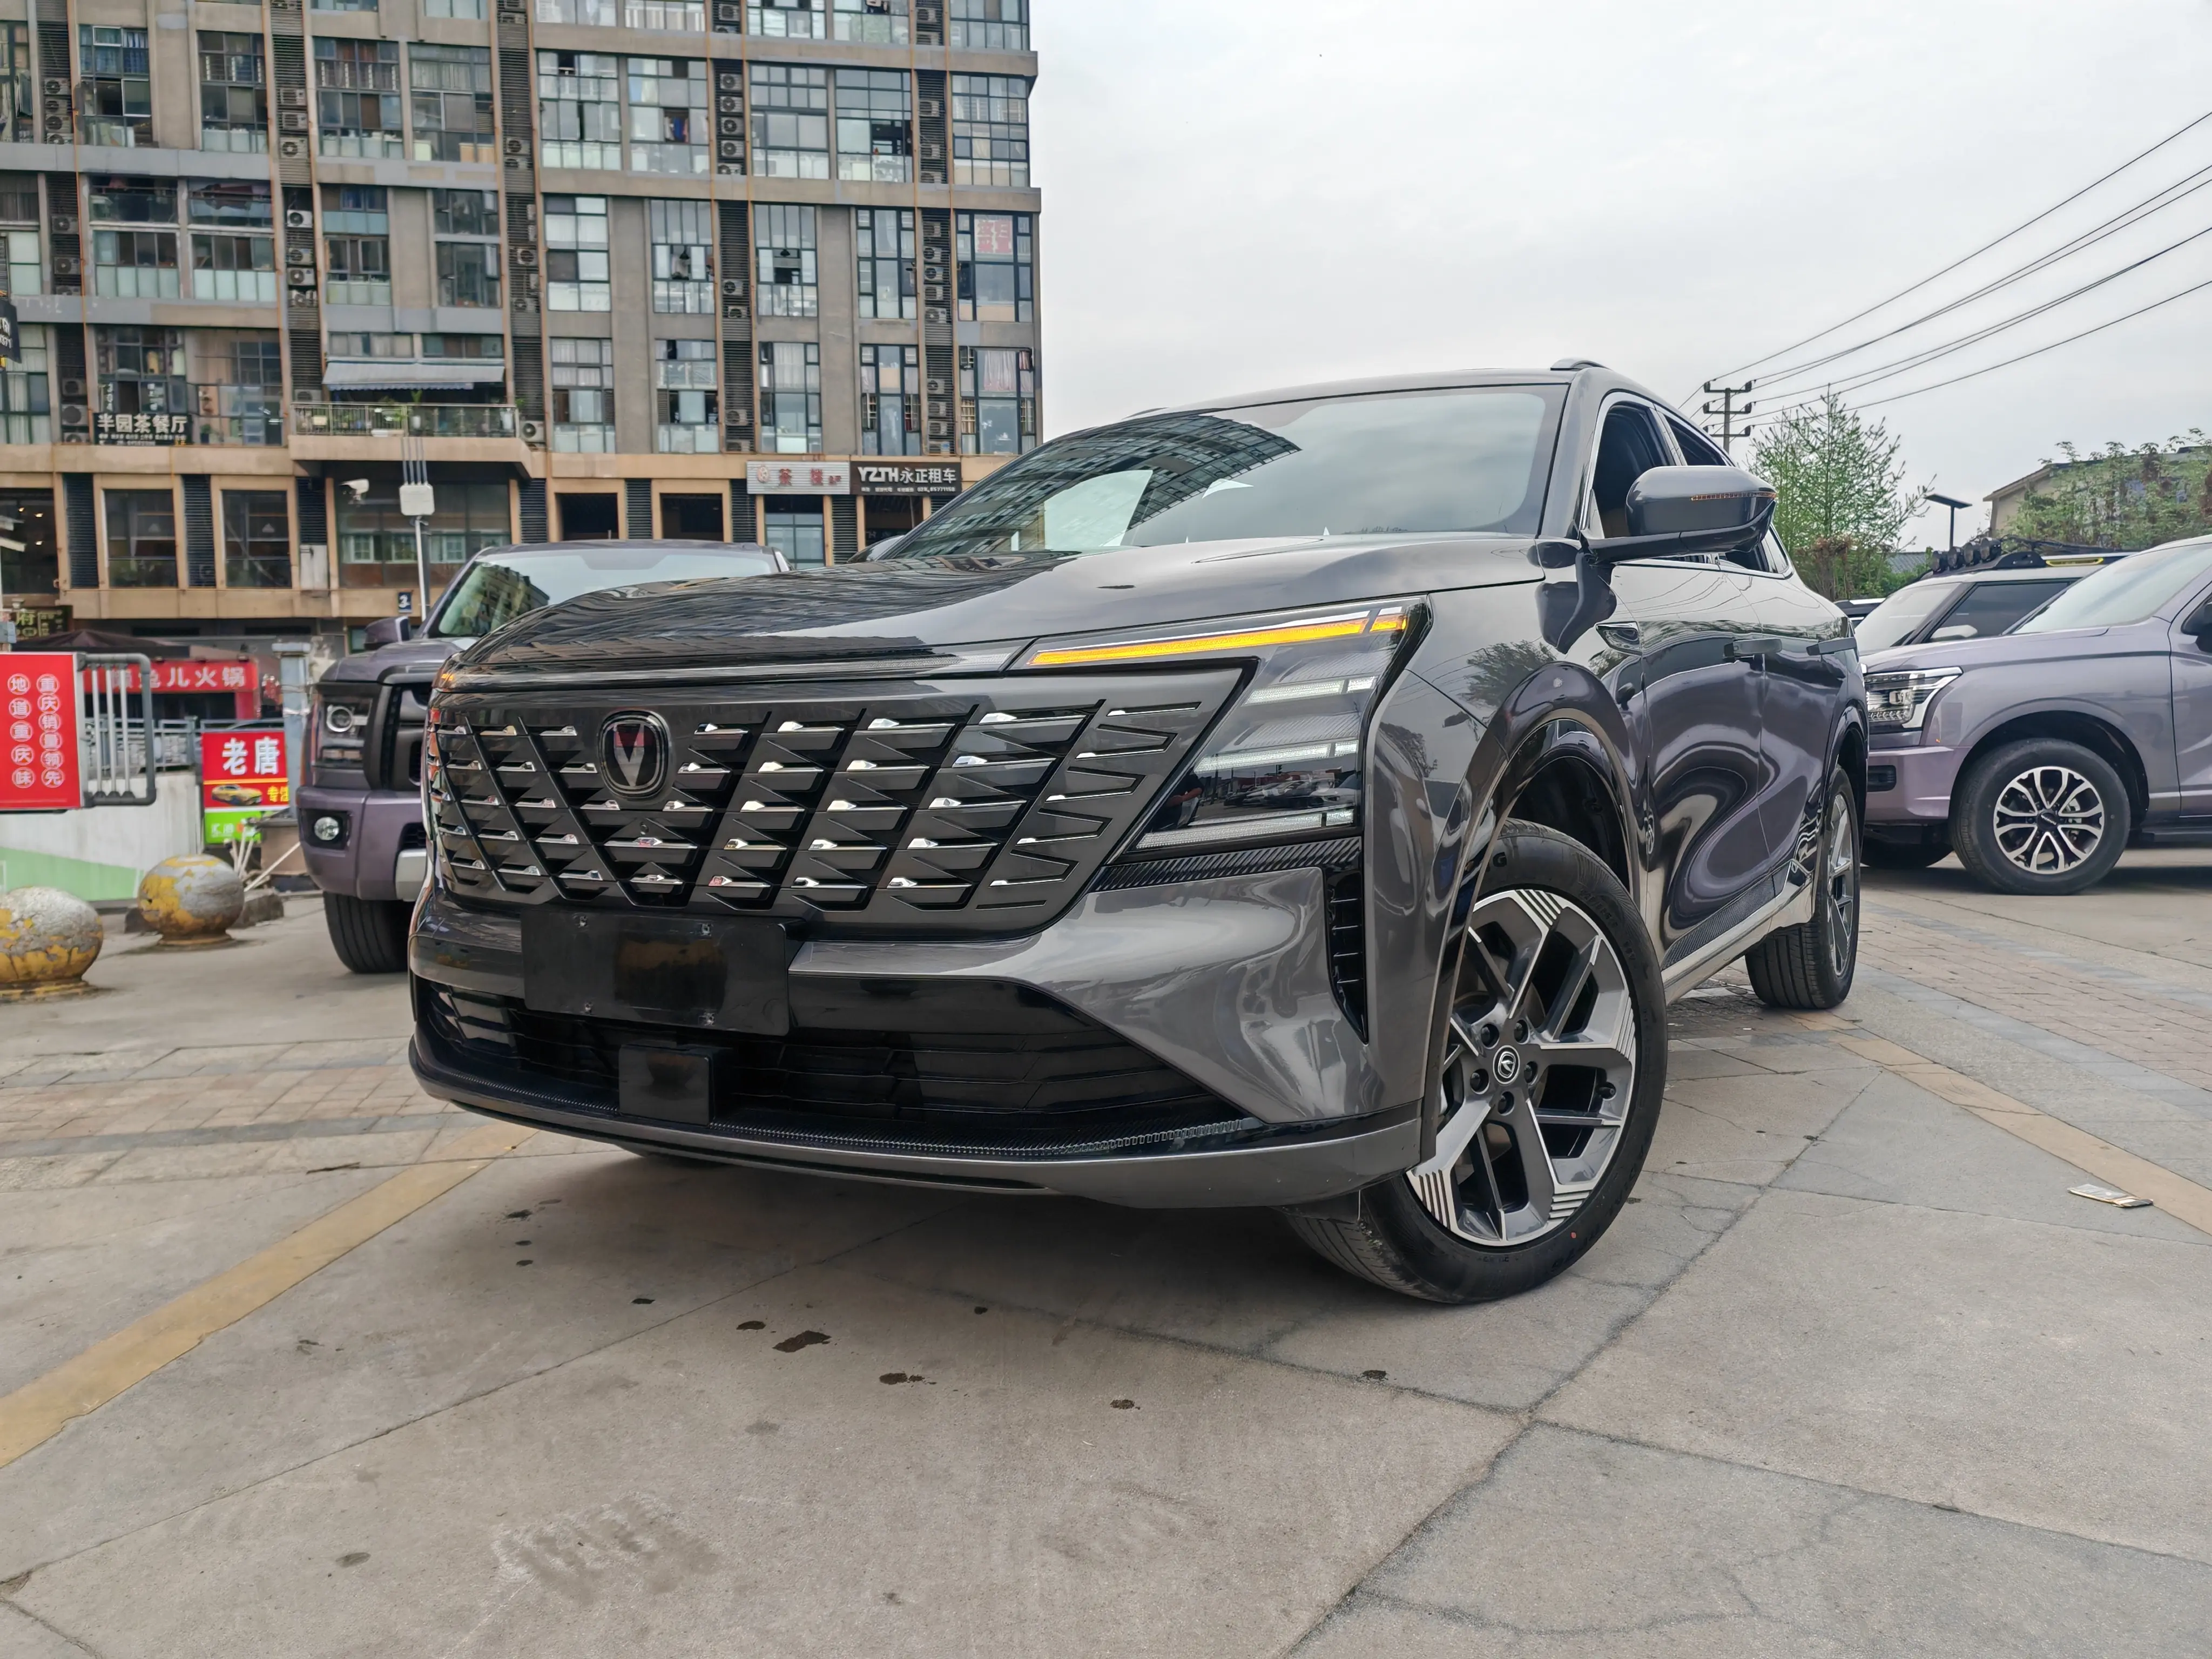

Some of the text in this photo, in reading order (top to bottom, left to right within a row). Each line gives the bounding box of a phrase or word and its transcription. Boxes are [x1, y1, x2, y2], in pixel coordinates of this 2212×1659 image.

[97, 413, 187, 434] 半园茶餐厅
[900, 467, 956, 483] 永正租车
[222, 736, 280, 775] 老唐
